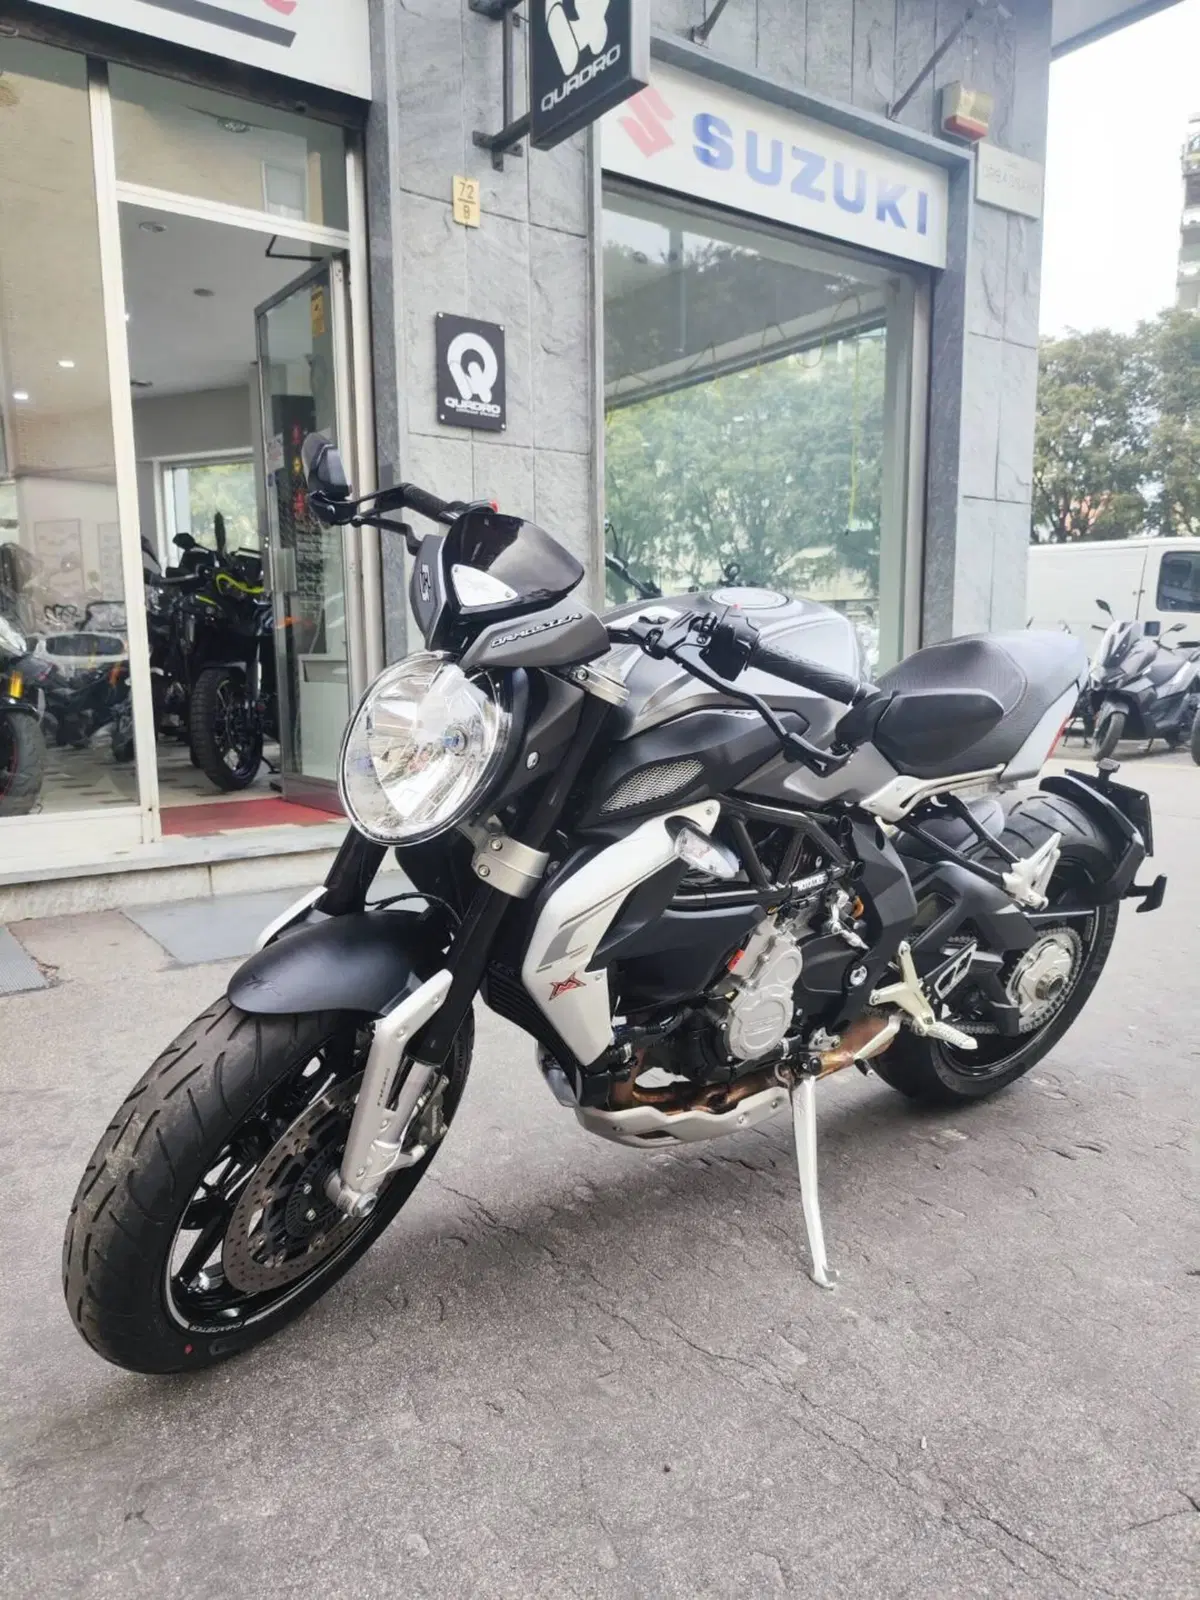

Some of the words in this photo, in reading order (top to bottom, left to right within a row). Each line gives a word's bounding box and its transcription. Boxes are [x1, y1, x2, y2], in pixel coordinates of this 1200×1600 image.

[541, 43, 621, 112] QUADRO
[458, 181, 475, 200] 72
[692, 112, 928, 236] SUZUKI
[444, 396, 501, 414] QUADRO
[490, 613, 583, 648] DRAGSTER
